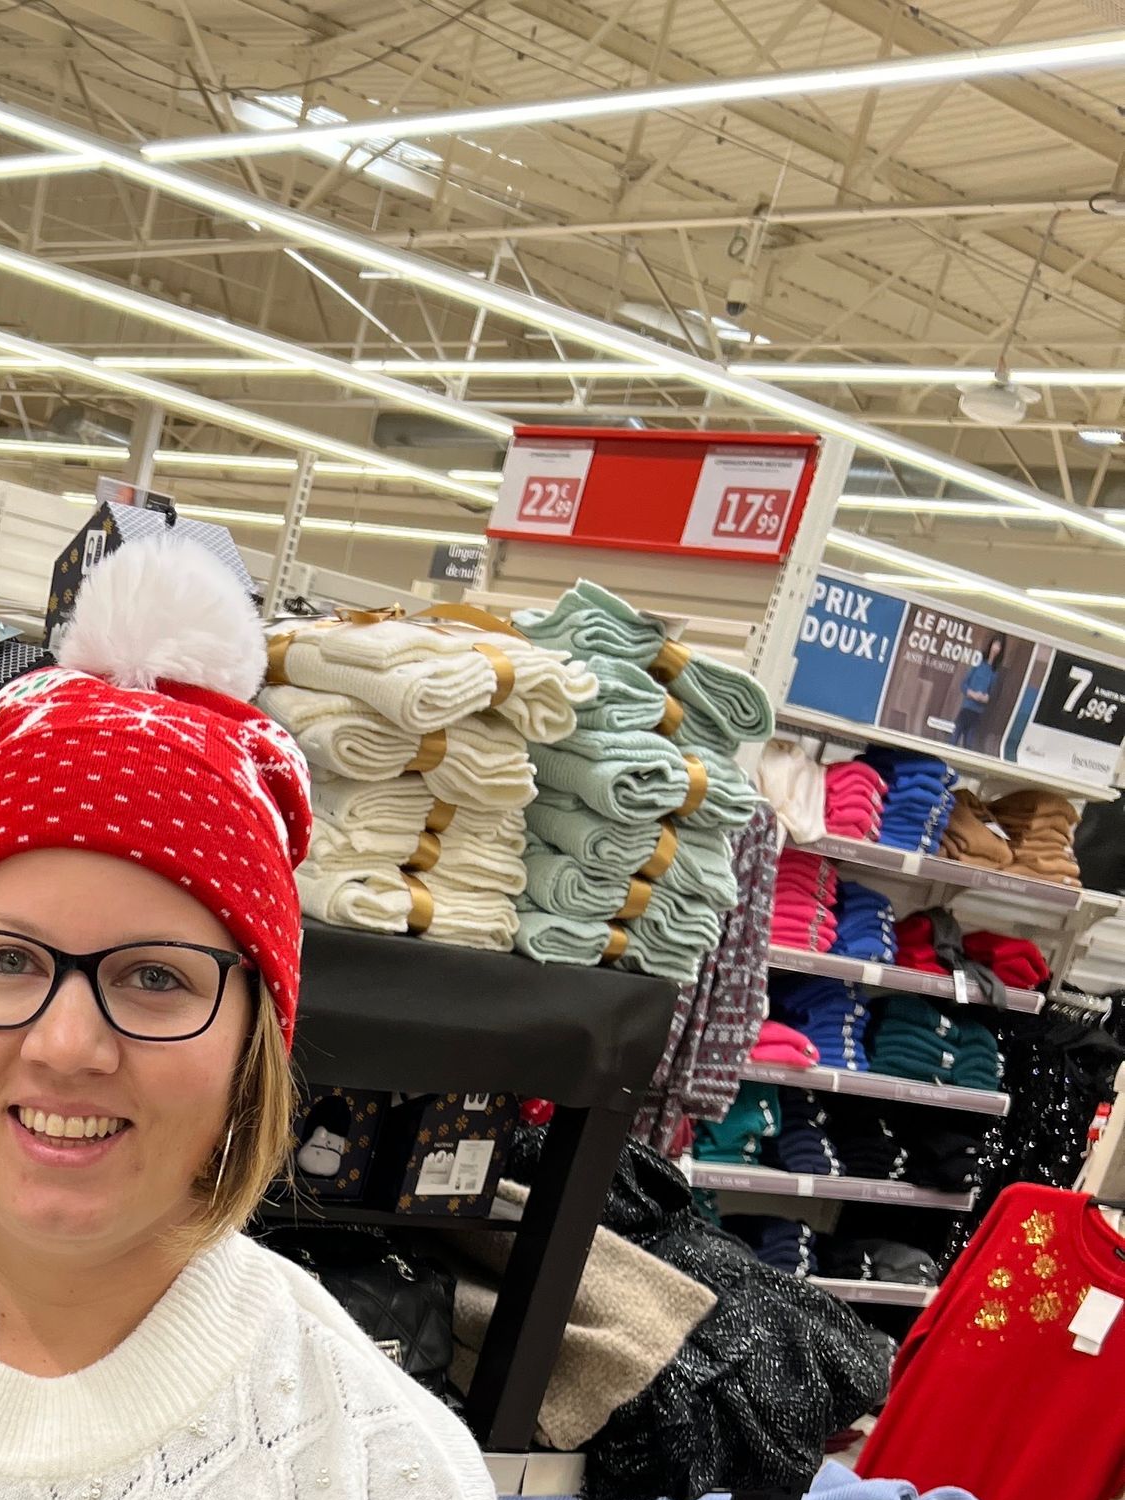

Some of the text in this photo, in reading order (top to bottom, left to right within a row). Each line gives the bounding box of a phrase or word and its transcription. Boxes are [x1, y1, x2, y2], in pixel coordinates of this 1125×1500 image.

[808, 581, 873, 624] PRIX
[800, 614, 877, 659] DOUX
[914, 610, 973, 644] LE PULL
[908, 630, 938, 655] COL
[940, 640, 983, 667] ROND
